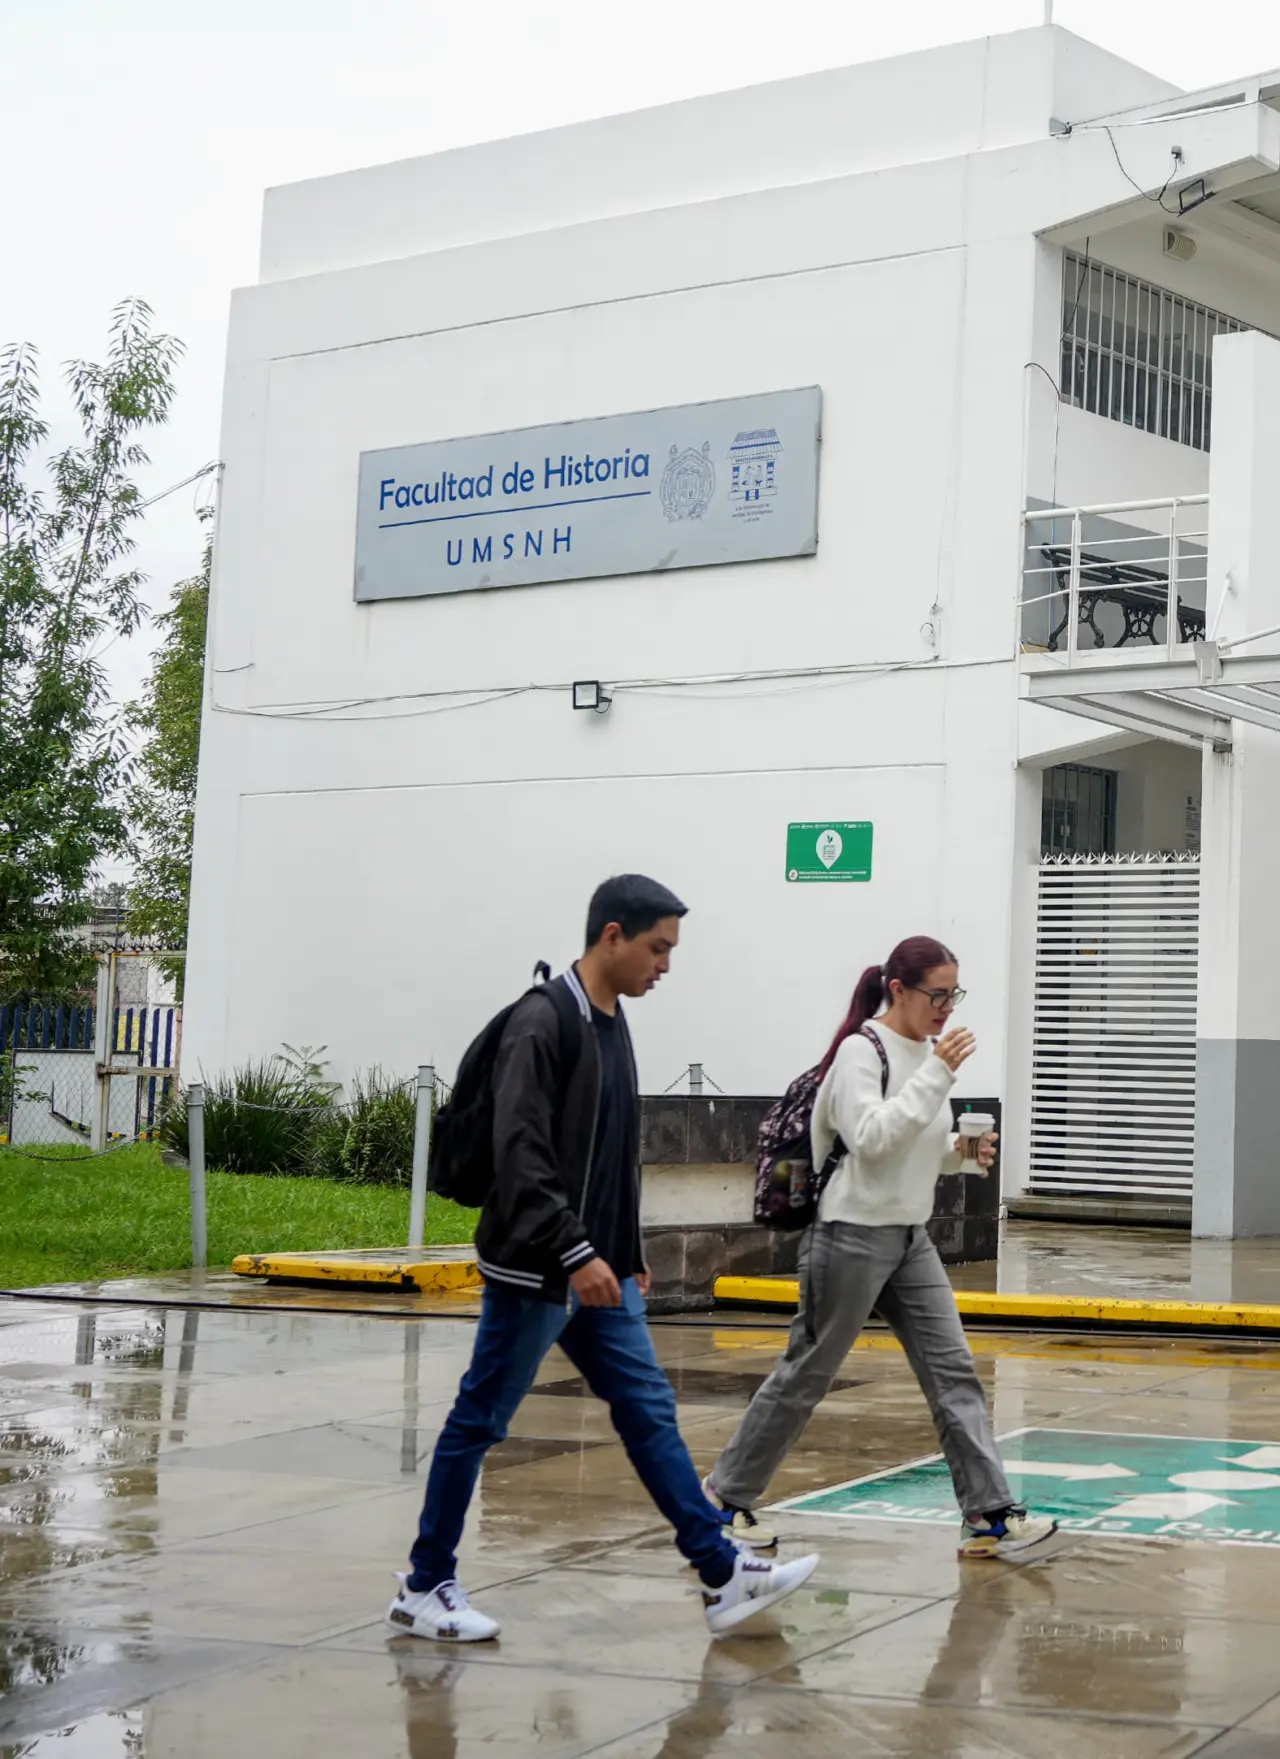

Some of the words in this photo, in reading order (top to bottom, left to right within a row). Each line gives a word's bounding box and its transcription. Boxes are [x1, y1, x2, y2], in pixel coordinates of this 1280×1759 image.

[379, 465, 495, 511] Facultad
[501, 462, 535, 495] de
[543, 447, 651, 490] Historia
[839, 1499, 960, 1519] Pun
[1059, 1516, 1132, 1530] de
